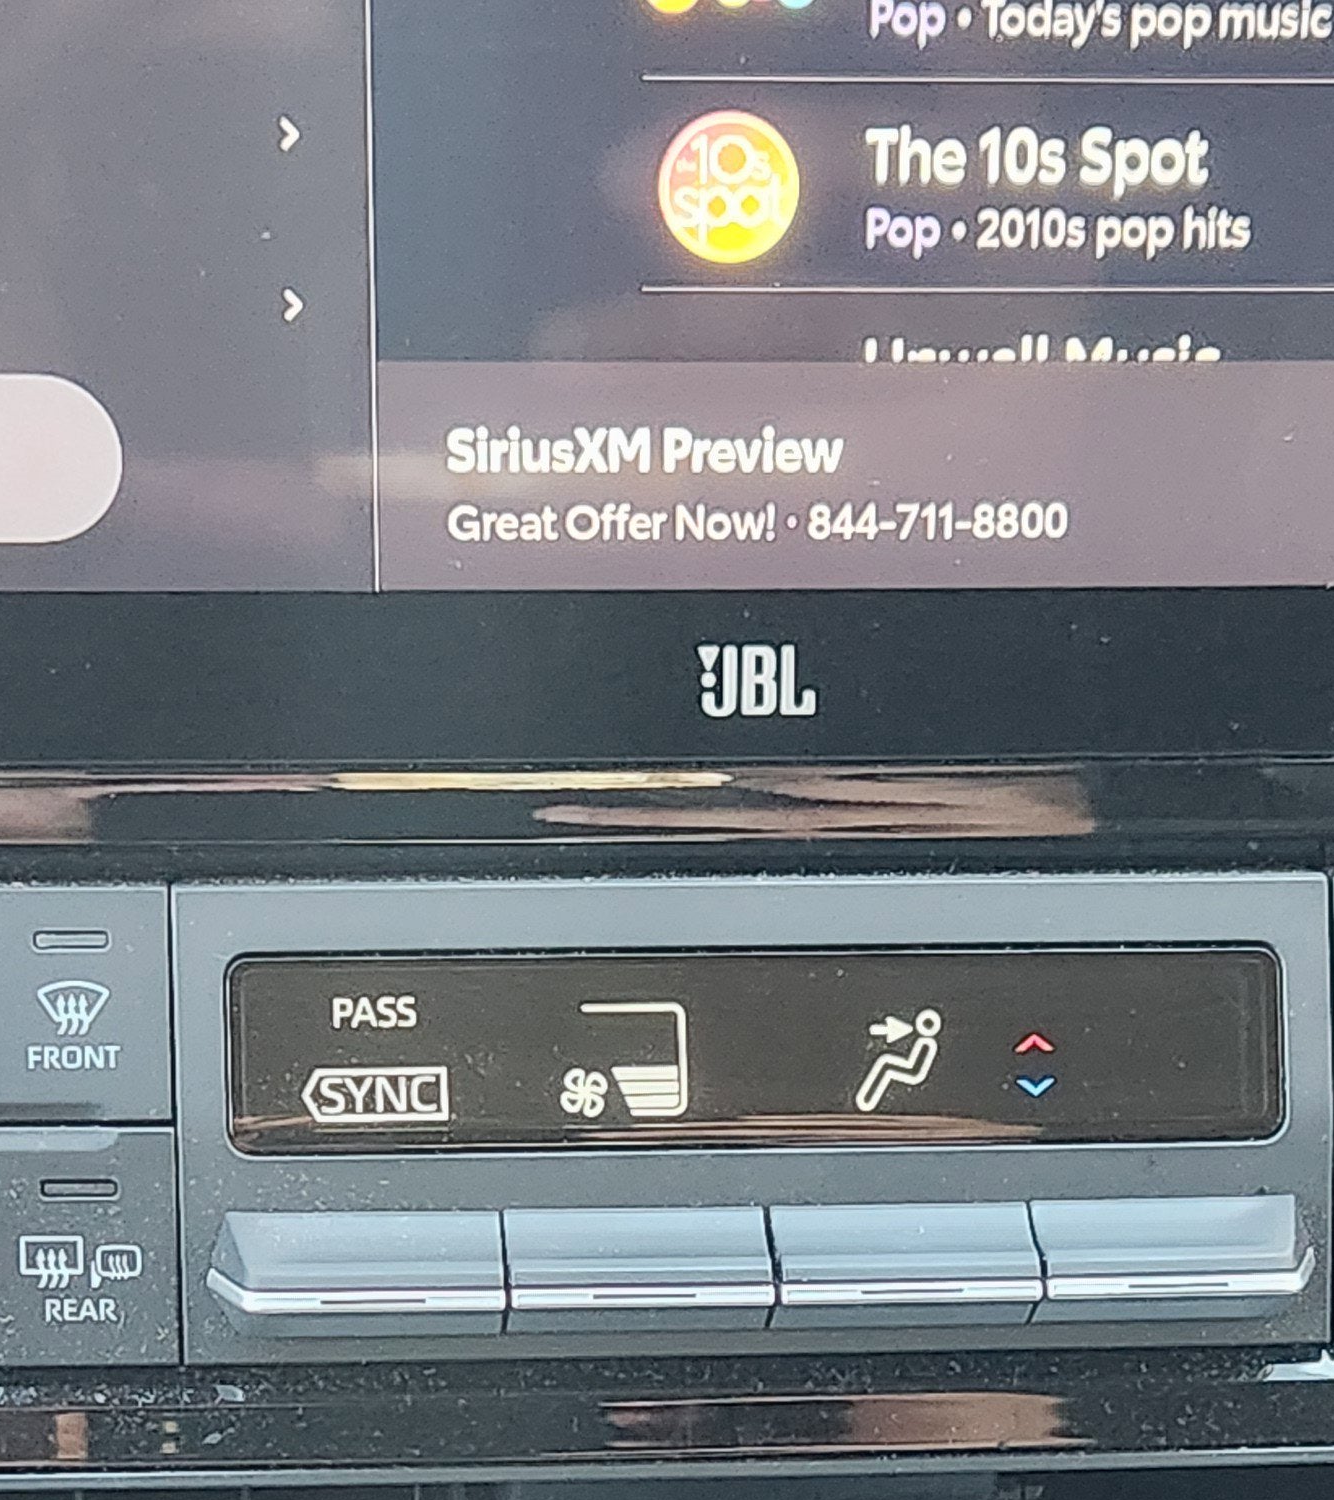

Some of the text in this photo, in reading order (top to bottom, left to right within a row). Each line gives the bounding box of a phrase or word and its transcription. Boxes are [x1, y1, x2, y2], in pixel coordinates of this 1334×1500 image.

[869, 0, 1334, 50] Pop Today's pop music
[865, 124, 1209, 200] The 10s Spot
[866, 205, 1252, 260] Pop 2010s pop hits
[446, 424, 845, 474] SiriusXM Preview
[447, 501, 1069, 542] Great Offer Now! 844-711-8800
[696, 643, 817, 718] JBL
[331, 996, 418, 1028] PASS
[26, 1045, 121, 1070] FRONT
[318, 1074, 439, 1114] SYNC
[44, 1298, 118, 1323] REAR
